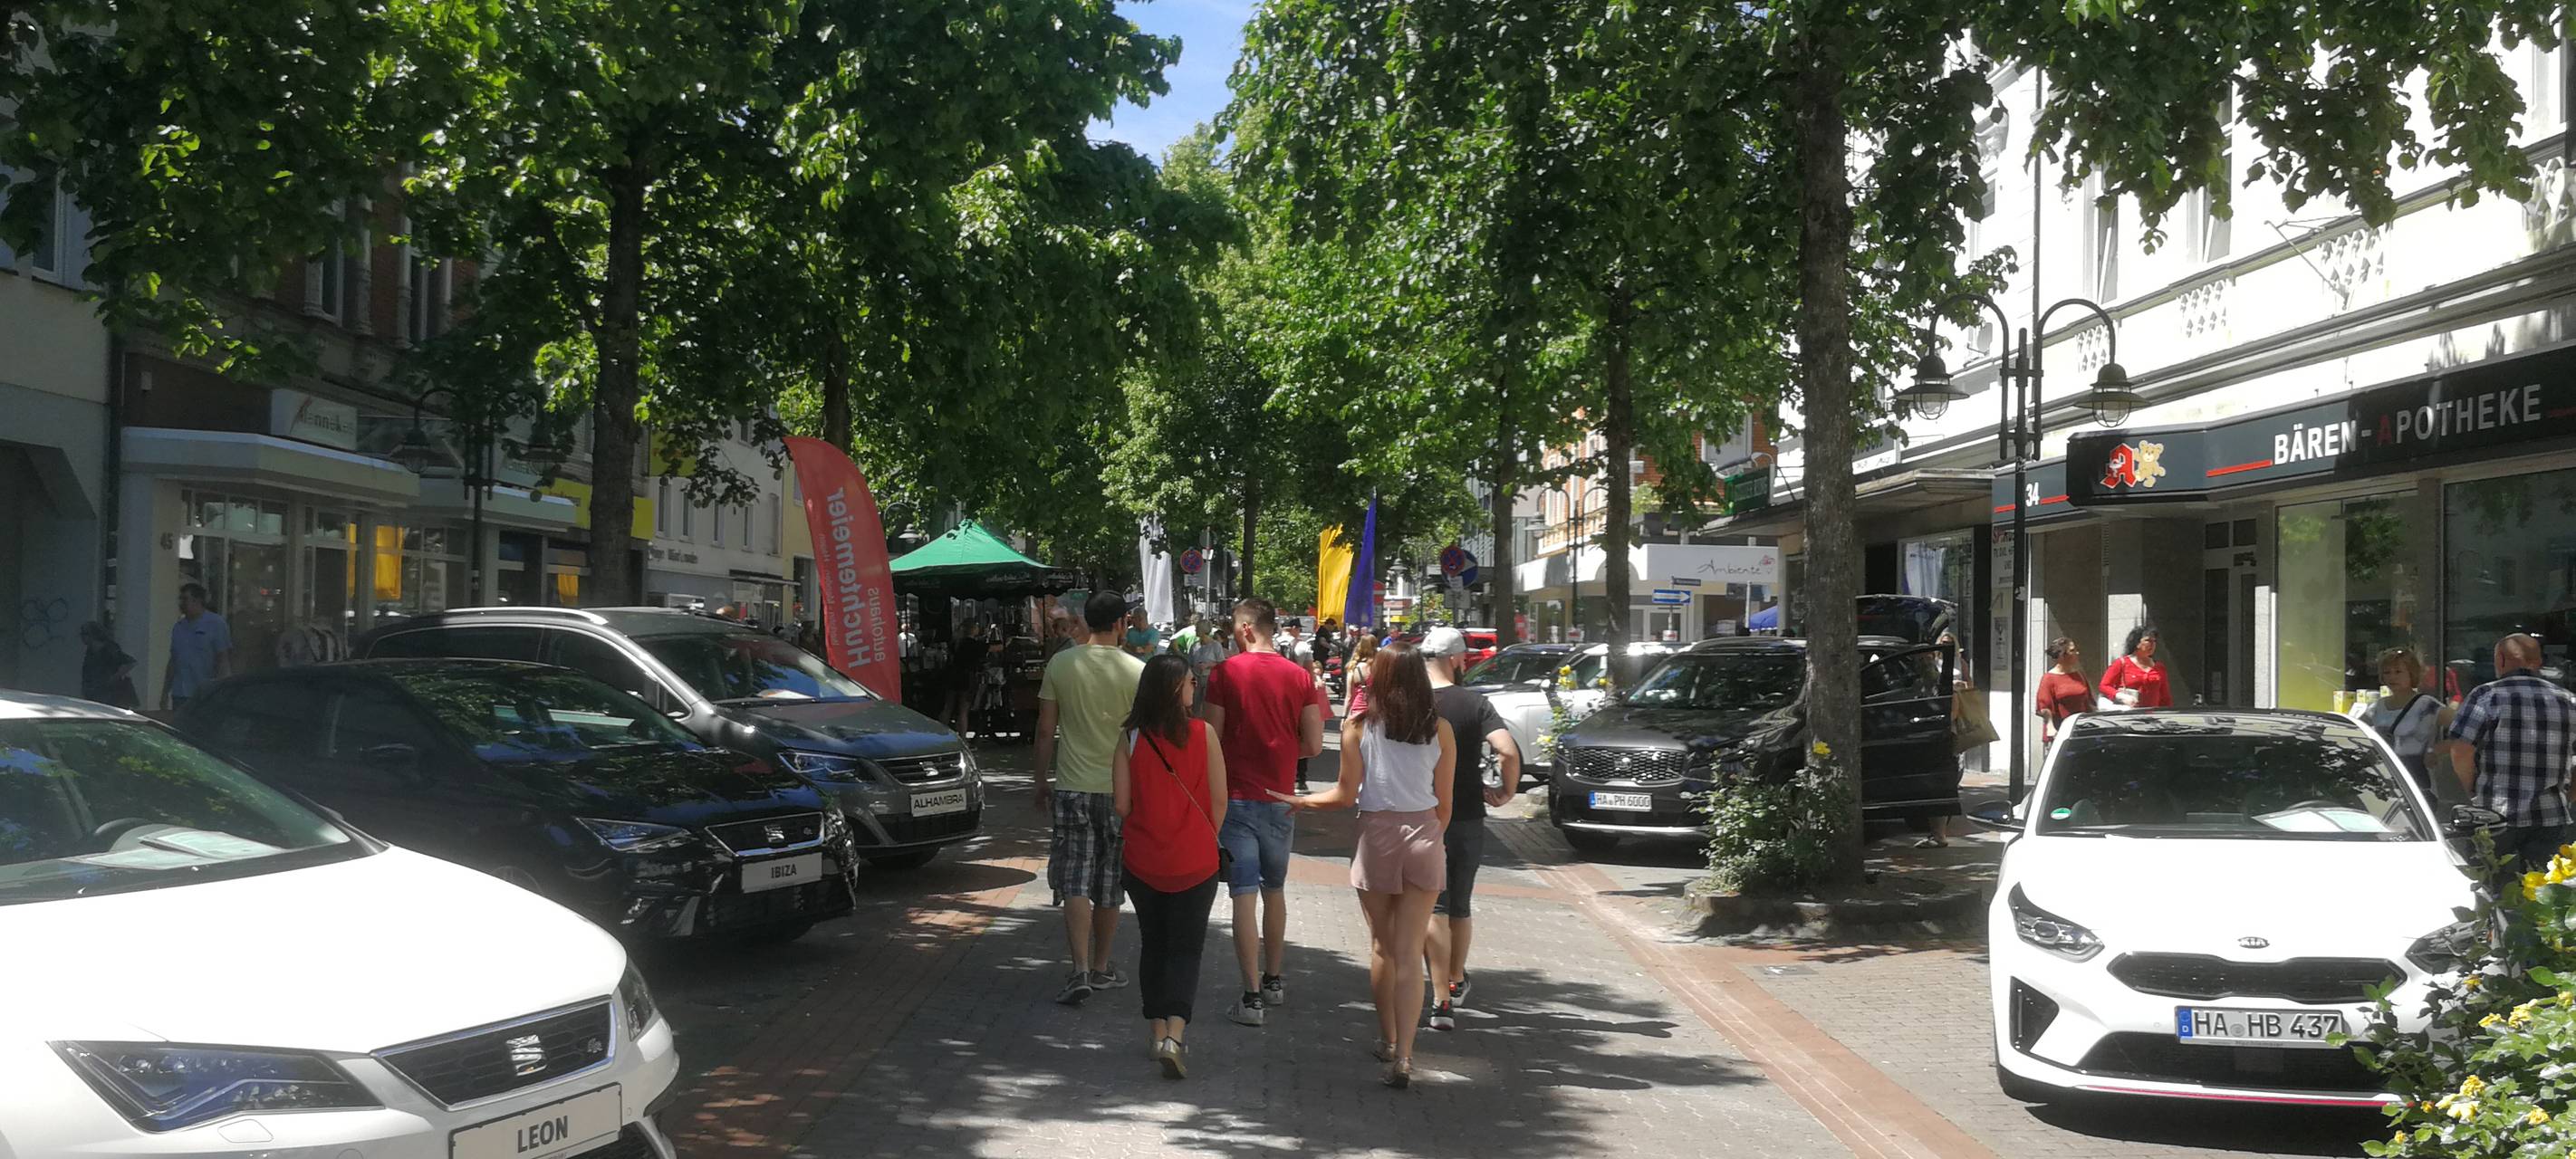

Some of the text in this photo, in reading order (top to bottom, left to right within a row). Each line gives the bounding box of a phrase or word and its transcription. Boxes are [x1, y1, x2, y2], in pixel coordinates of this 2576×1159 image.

[2025, 482, 2040, 507] 34
[913, 792, 965, 809] ALHAMBRA
[1596, 793, 1608, 805] HA
[771, 863, 797, 879] IBIZA
[2194, 1011, 2228, 1037] HA
[2246, 1012, 2282, 1037] HB
[2290, 1013, 2340, 1039] 437
[517, 1115, 569, 1154] LEON
